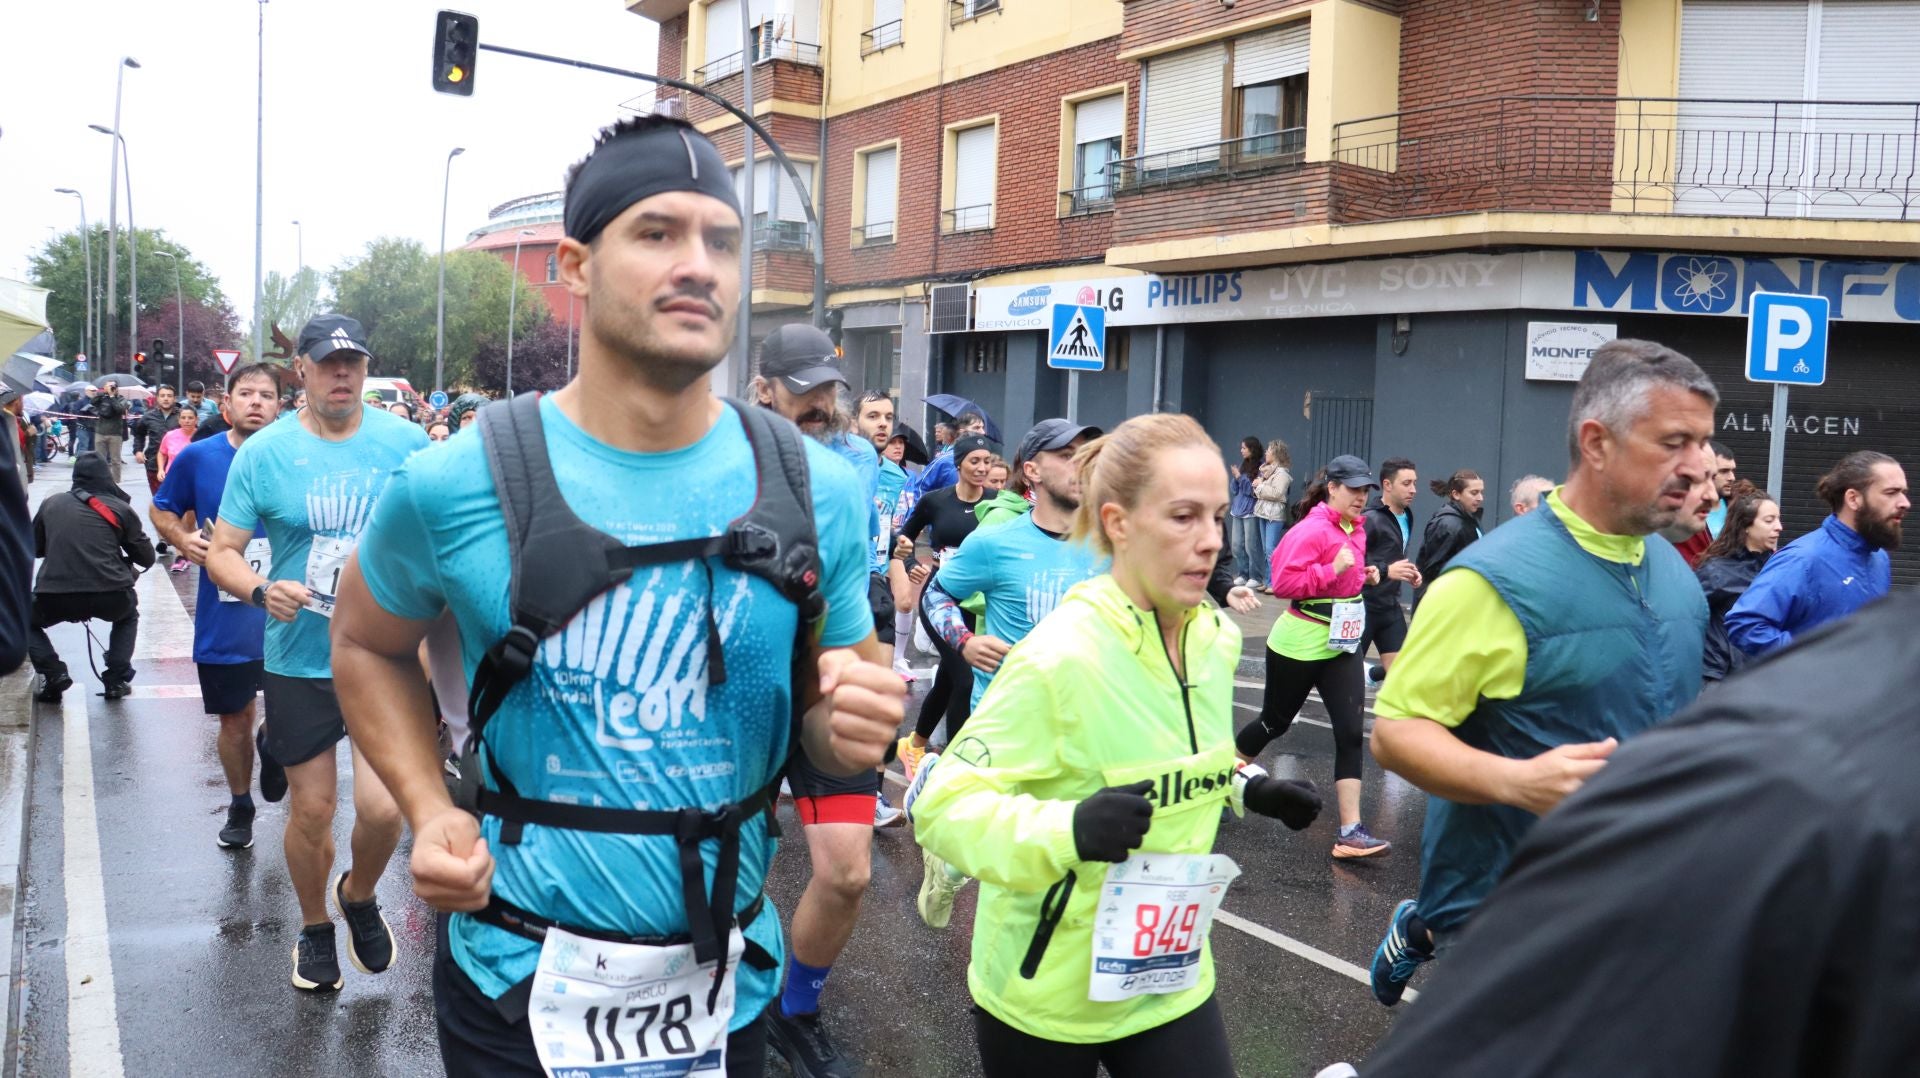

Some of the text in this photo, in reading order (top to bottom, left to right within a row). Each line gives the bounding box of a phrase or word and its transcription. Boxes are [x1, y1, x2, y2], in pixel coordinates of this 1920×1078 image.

[1147, 271, 1243, 309] PHILIPS
[1270, 264, 1347, 301] JVC
[1379, 260, 1503, 292] SONY
[1096, 286, 1124, 313] LG
[1262, 302, 1357, 317] TECNICA
[977, 318, 1042, 329] SERVICIO
[1560, 325, 1588, 333] TECNICO
[1765, 304, 1813, 372] P
[1133, 903, 1200, 957] 849
[625, 982, 668, 1004] PABLO
[584, 993, 696, 1063] 1178
